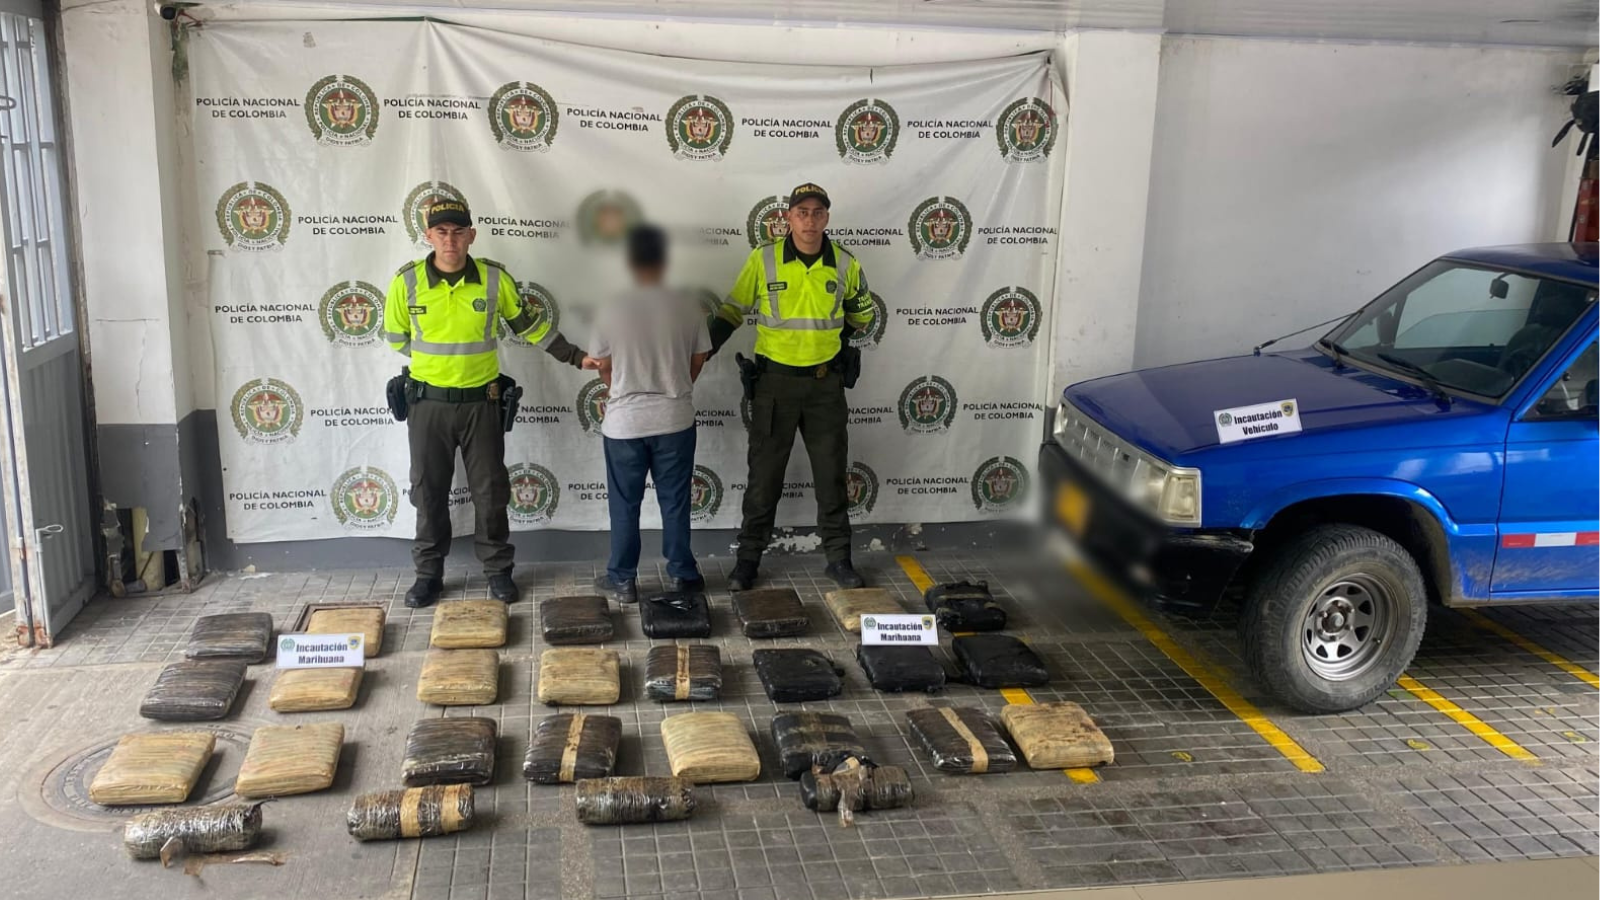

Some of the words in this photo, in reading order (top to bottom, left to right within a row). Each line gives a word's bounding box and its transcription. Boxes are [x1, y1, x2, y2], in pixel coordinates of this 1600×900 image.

[196, 96, 240, 106] POLICÍA
[243, 98, 300, 107] NACIONAL
[383, 97, 423, 108] POLICÍA
[426, 99, 481, 109] NACIONAL
[212, 109, 226, 118] DE
[229, 109, 287, 118] COLOMBIA
[399, 110, 412, 118] DE
[414, 110, 468, 120] COLOMBIA
[567, 107, 606, 117] POLICÍA
[609, 111, 662, 123] NACIONAL
[579, 120, 592, 128] DE
[595, 121, 649, 132] COLOMBIA
[742, 117, 779, 128] POLICÍA
[781, 119, 832, 128] NACIONAL
[907, 118, 943, 128] POLICÍA
[945, 120, 994, 129] NACIONAL
[753, 129, 766, 138] DE
[769, 129, 819, 139] COLOMBIA
[918, 130, 930, 139] DE
[932, 130, 981, 139] COLOMBIA
[298, 215, 339, 225] POLICÍA
[341, 215, 398, 224] NACIONAL
[478, 216, 518, 225] POLICÍA
[313, 226, 327, 235] DE
[329, 225, 385, 235] COLOMBIA
[824, 227, 853, 236] OLICÍA
[856, 227, 904, 236] NACIONAL
[978, 224, 1011, 235] POLICÍA
[1013, 225, 1058, 235] NACIONAL
[843, 238, 891, 246] COLOMBIA
[986, 236, 999, 244] DE
[1001, 236, 1049, 244] COLOMBIA
[215, 302, 256, 313] POLICÍA
[259, 303, 315, 312] NACIONAL
[896, 305, 929, 316] POLICÍA
[931, 306, 979, 315] NACIONAL
[230, 315, 245, 324] DE
[246, 314, 303, 323] COLOMBIA
[907, 317, 920, 326] DE
[922, 316, 967, 326] COLOMBIA
[311, 407, 353, 417] POLICÍA
[354, 406, 393, 416] NACION
[521, 405, 573, 413] NACIONAL
[848, 406, 894, 415] NACIONAL
[963, 402, 997, 411] POLICÍA
[999, 403, 1044, 411] NACIONAL
[694, 409, 737, 418] ACIONAL
[974, 412, 986, 420] DE
[988, 411, 1034, 420] COLOMBIA
[1234, 410, 1283, 424] Incautación
[324, 419, 338, 427] DE
[340, 417, 395, 427] COLOMBIA
[514, 415, 560, 424] OLOMBIA
[848, 416, 882, 425] LOMBIA
[886, 476, 921, 486] POLICÍA
[921, 477, 969, 485] NACIONAL
[568, 482, 606, 491] POLICÍA
[896, 487, 910, 495] DE
[911, 485, 958, 495] COLOMBIA
[229, 490, 271, 501] POLICÍA
[273, 489, 327, 499] NACIONAL
[580, 492, 595, 500] DE
[243, 502, 258, 510] DE
[259, 500, 314, 510] COLOMBIA
[877, 622, 923, 631] Incautación
[880, 633, 922, 642] Marihuana
[295, 642, 348, 653] Incautación
[298, 655, 345, 664] Marihuana
